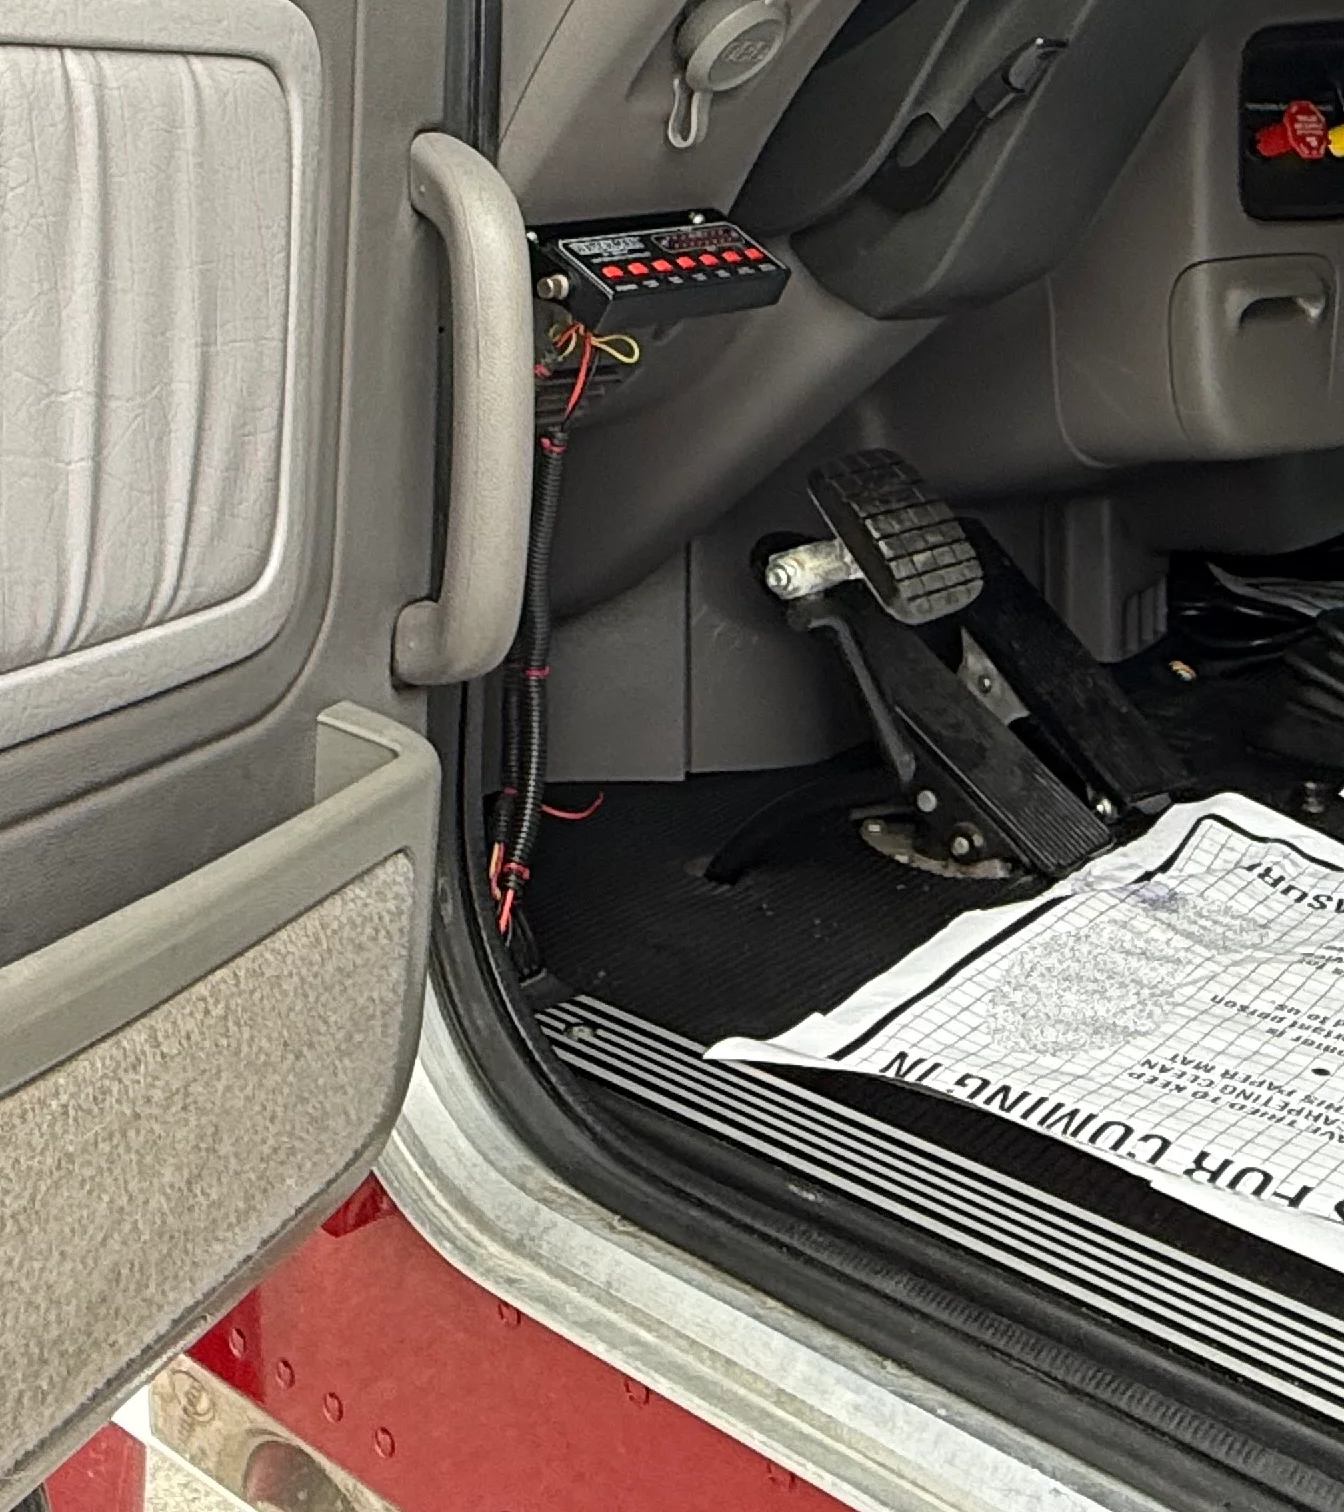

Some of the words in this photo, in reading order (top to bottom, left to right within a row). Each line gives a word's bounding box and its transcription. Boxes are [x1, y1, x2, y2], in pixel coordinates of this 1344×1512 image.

[1210, 993, 1286, 1026] person
[878, 1051, 943, 1083] IN
[1140, 1059, 1215, 1088] CLEAN
[1168, 1053, 1216, 1074] MAT
[1127, 1072, 1188, 1094] KEEP
[1191, 1090, 1222, 1105] TO
[1219, 1069, 1297, 1098] PAPER
